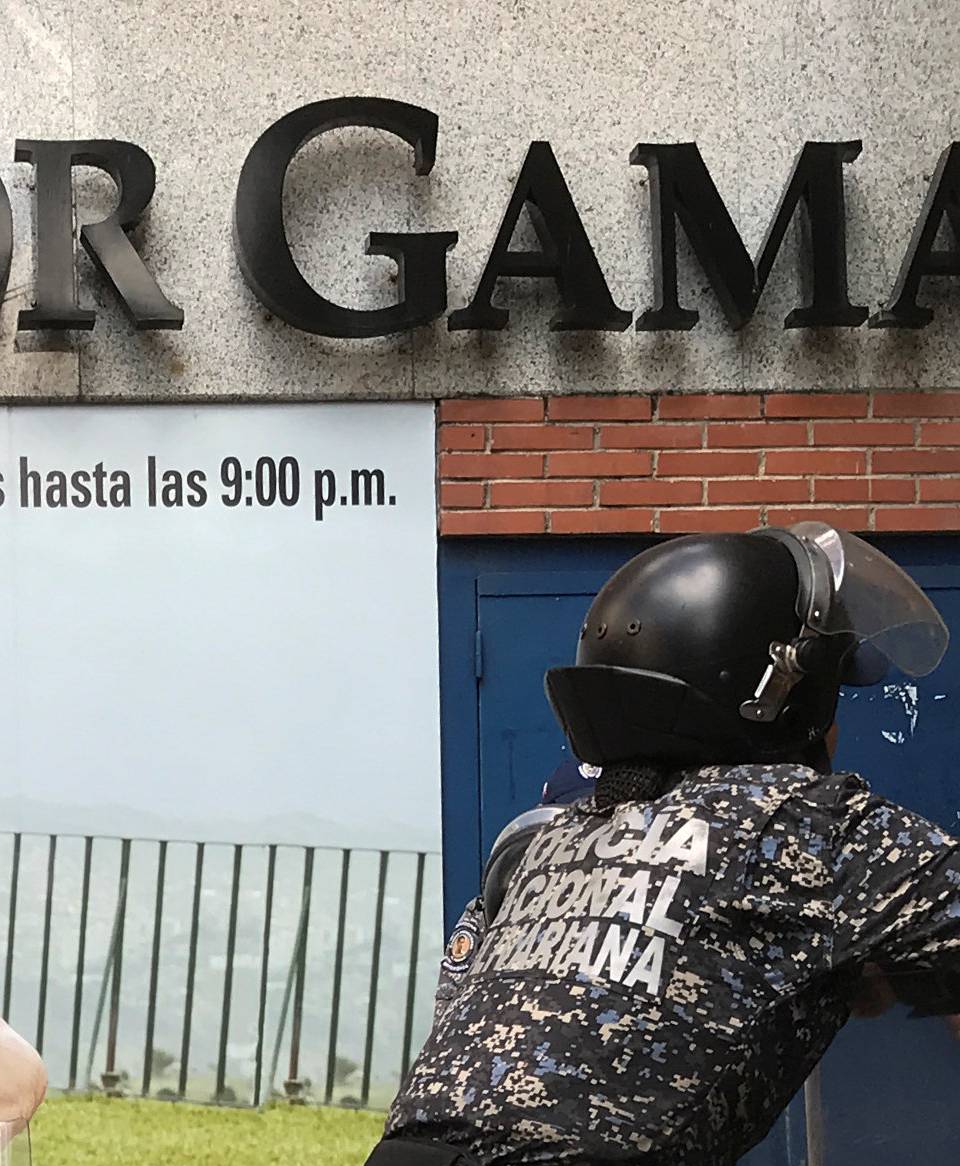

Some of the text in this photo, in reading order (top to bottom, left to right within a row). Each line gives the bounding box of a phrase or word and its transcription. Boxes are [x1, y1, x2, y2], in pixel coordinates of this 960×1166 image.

[19, 456, 131, 508] hasta
[148, 456, 207, 508] las
[220, 456, 300, 508] 9:00
[315, 464, 397, 521] p.m.
